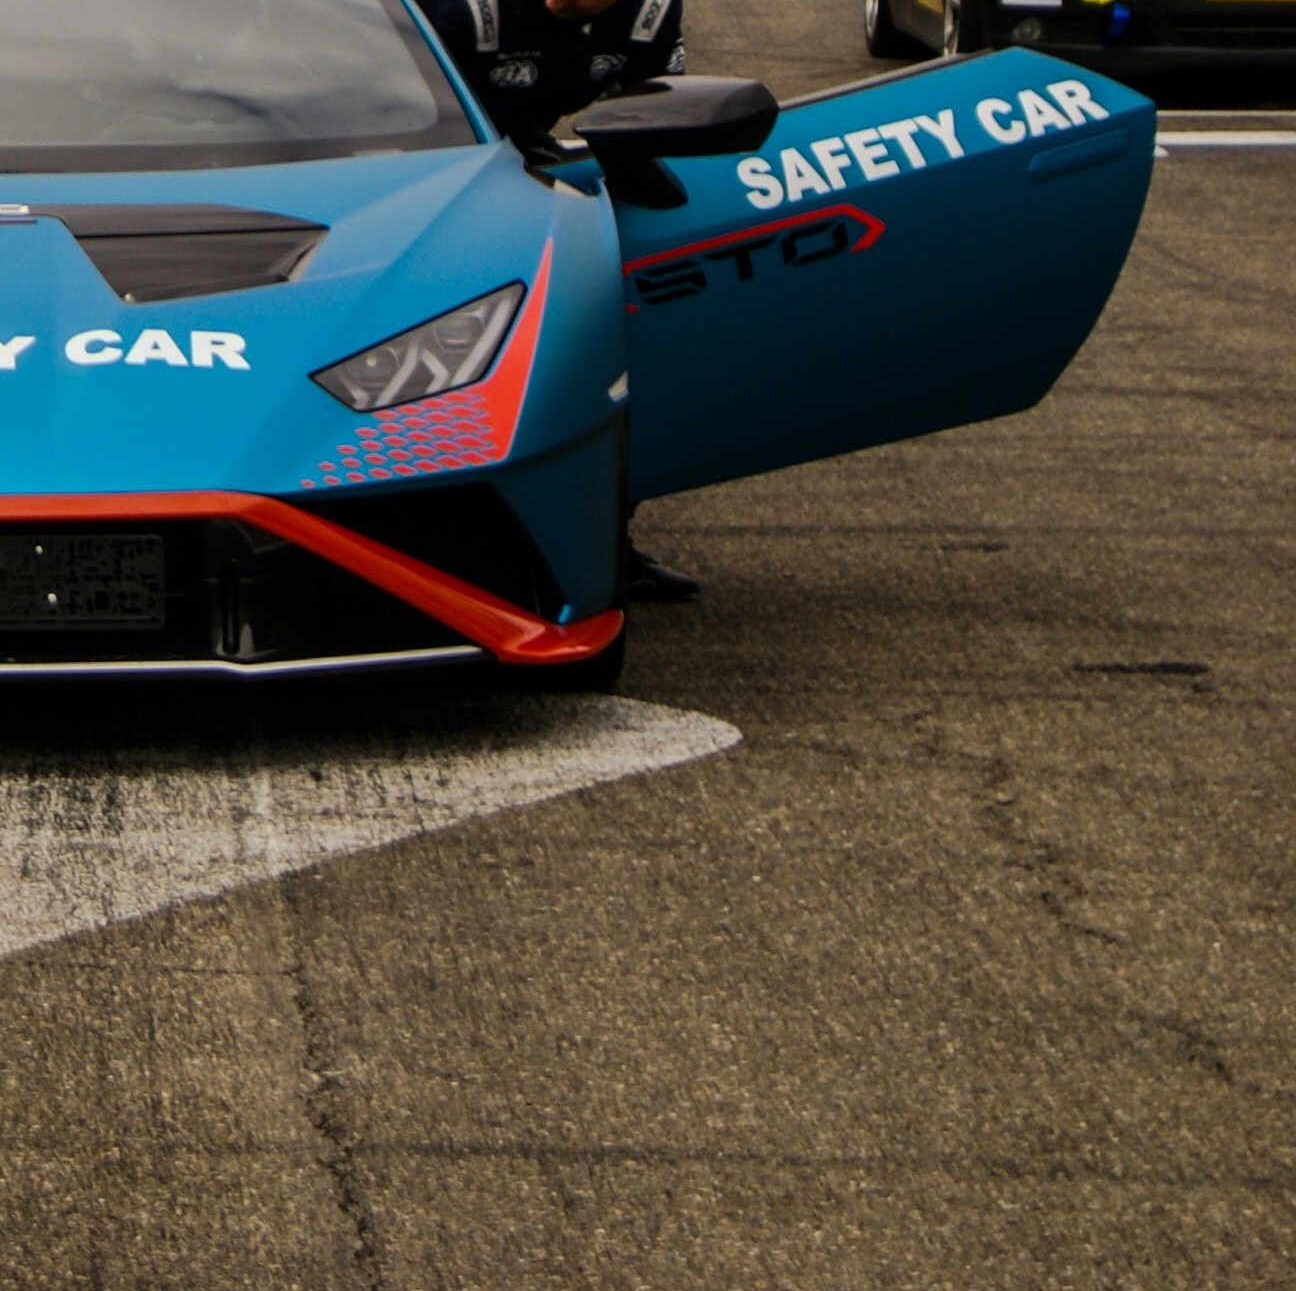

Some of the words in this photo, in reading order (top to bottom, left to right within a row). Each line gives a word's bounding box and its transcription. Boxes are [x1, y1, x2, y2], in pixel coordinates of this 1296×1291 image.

[736, 109, 966, 210] SAFETY
[974, 79, 1110, 145] CAR
[635, 220, 848, 305] STO
[64, 328, 251, 370] CAR
